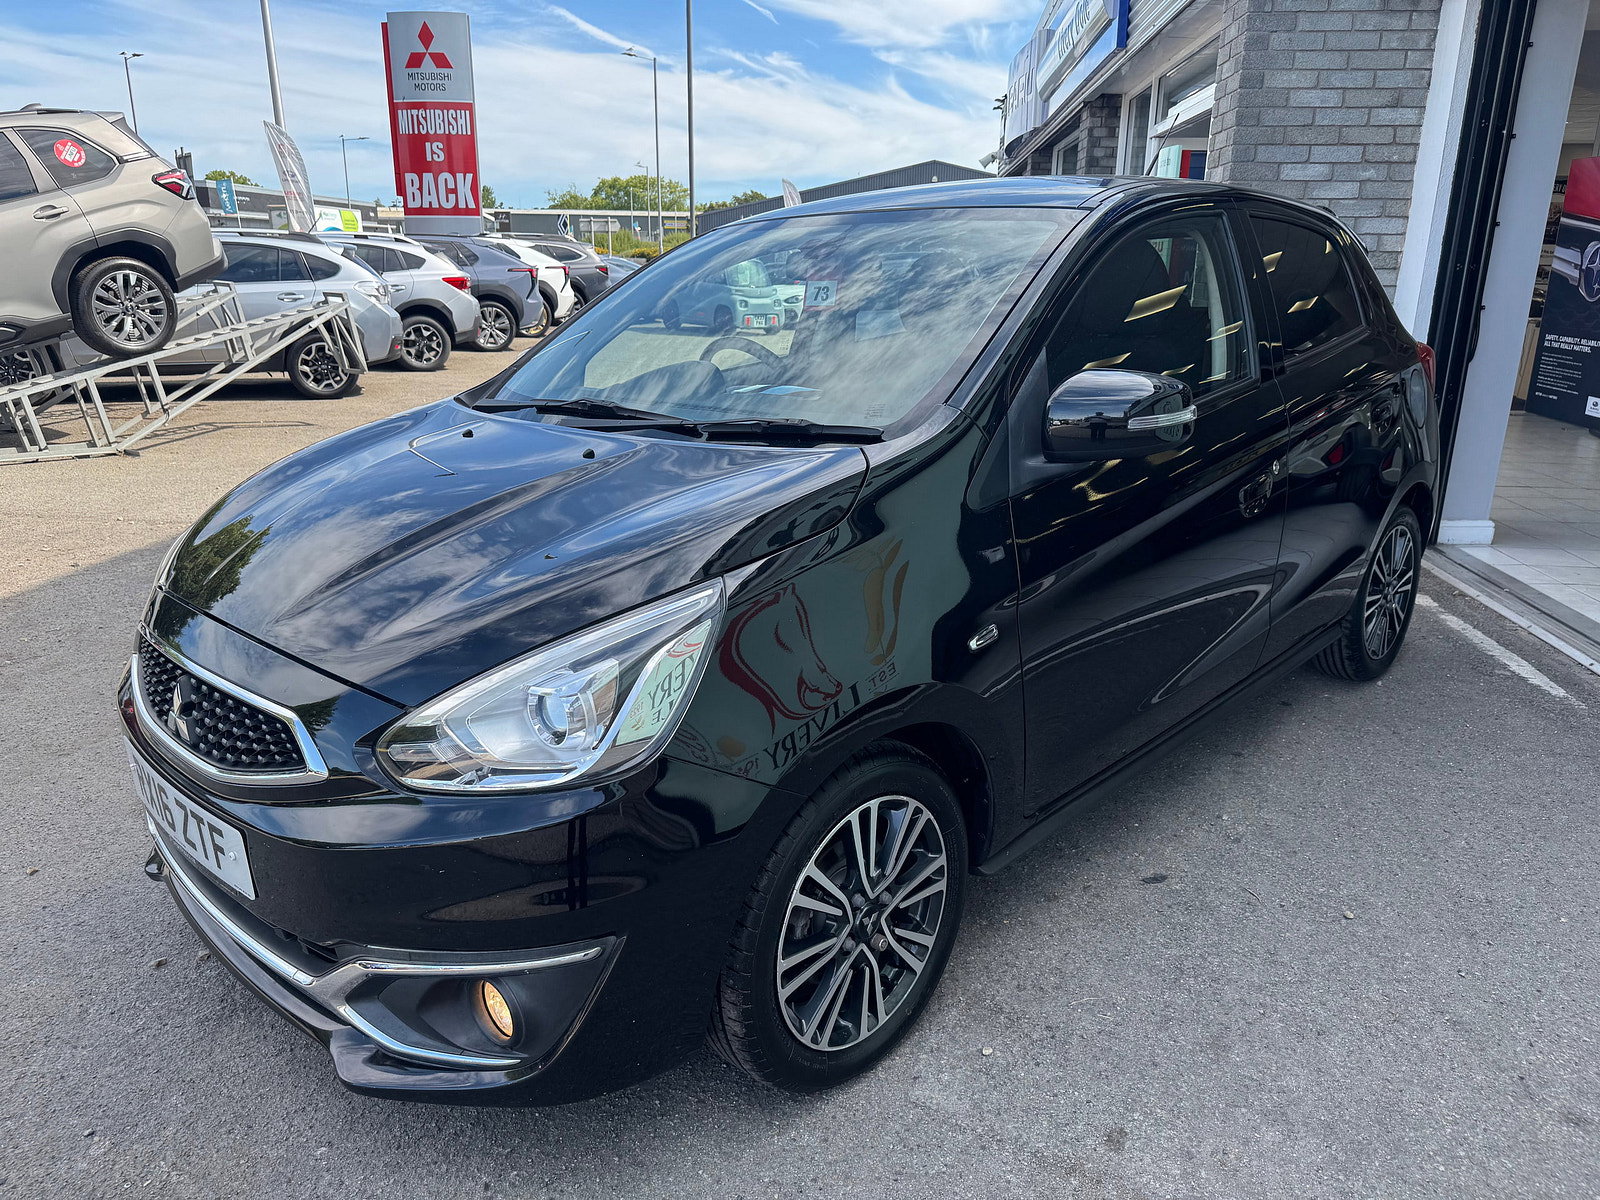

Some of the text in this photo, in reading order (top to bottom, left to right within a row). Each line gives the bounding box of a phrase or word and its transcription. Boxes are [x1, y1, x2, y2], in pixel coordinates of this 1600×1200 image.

[407, 72, 452, 81] MITSUBISHI
[414, 82, 447, 91] MOTORS
[397, 109, 471, 135] MITSUBISHI
[425, 142, 445, 161] IS
[404, 172, 476, 209] BACK
[813, 285, 830, 301] 73
[174, 797, 226, 870] ZTF
